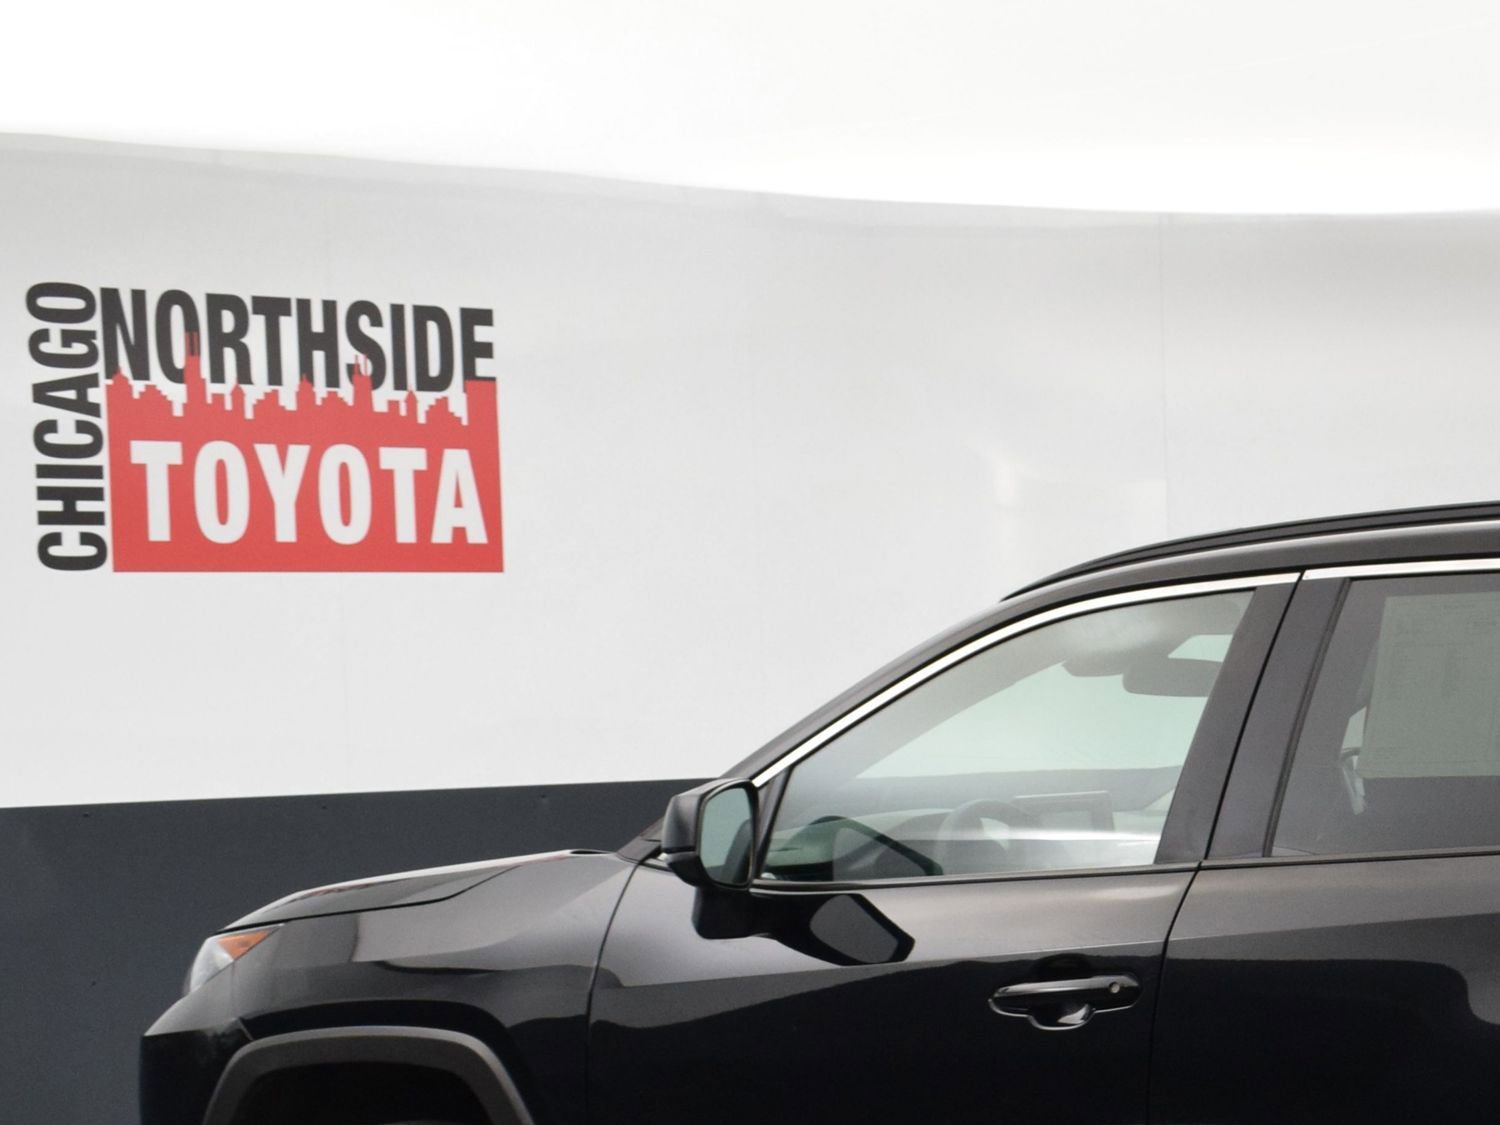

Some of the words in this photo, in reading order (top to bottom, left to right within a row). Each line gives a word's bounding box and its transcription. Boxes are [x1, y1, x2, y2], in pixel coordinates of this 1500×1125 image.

[100, 286, 497, 393] NORTHSIDE
[25, 281, 108, 572] CHICAGO
[129, 439, 489, 546] TOYOTA
